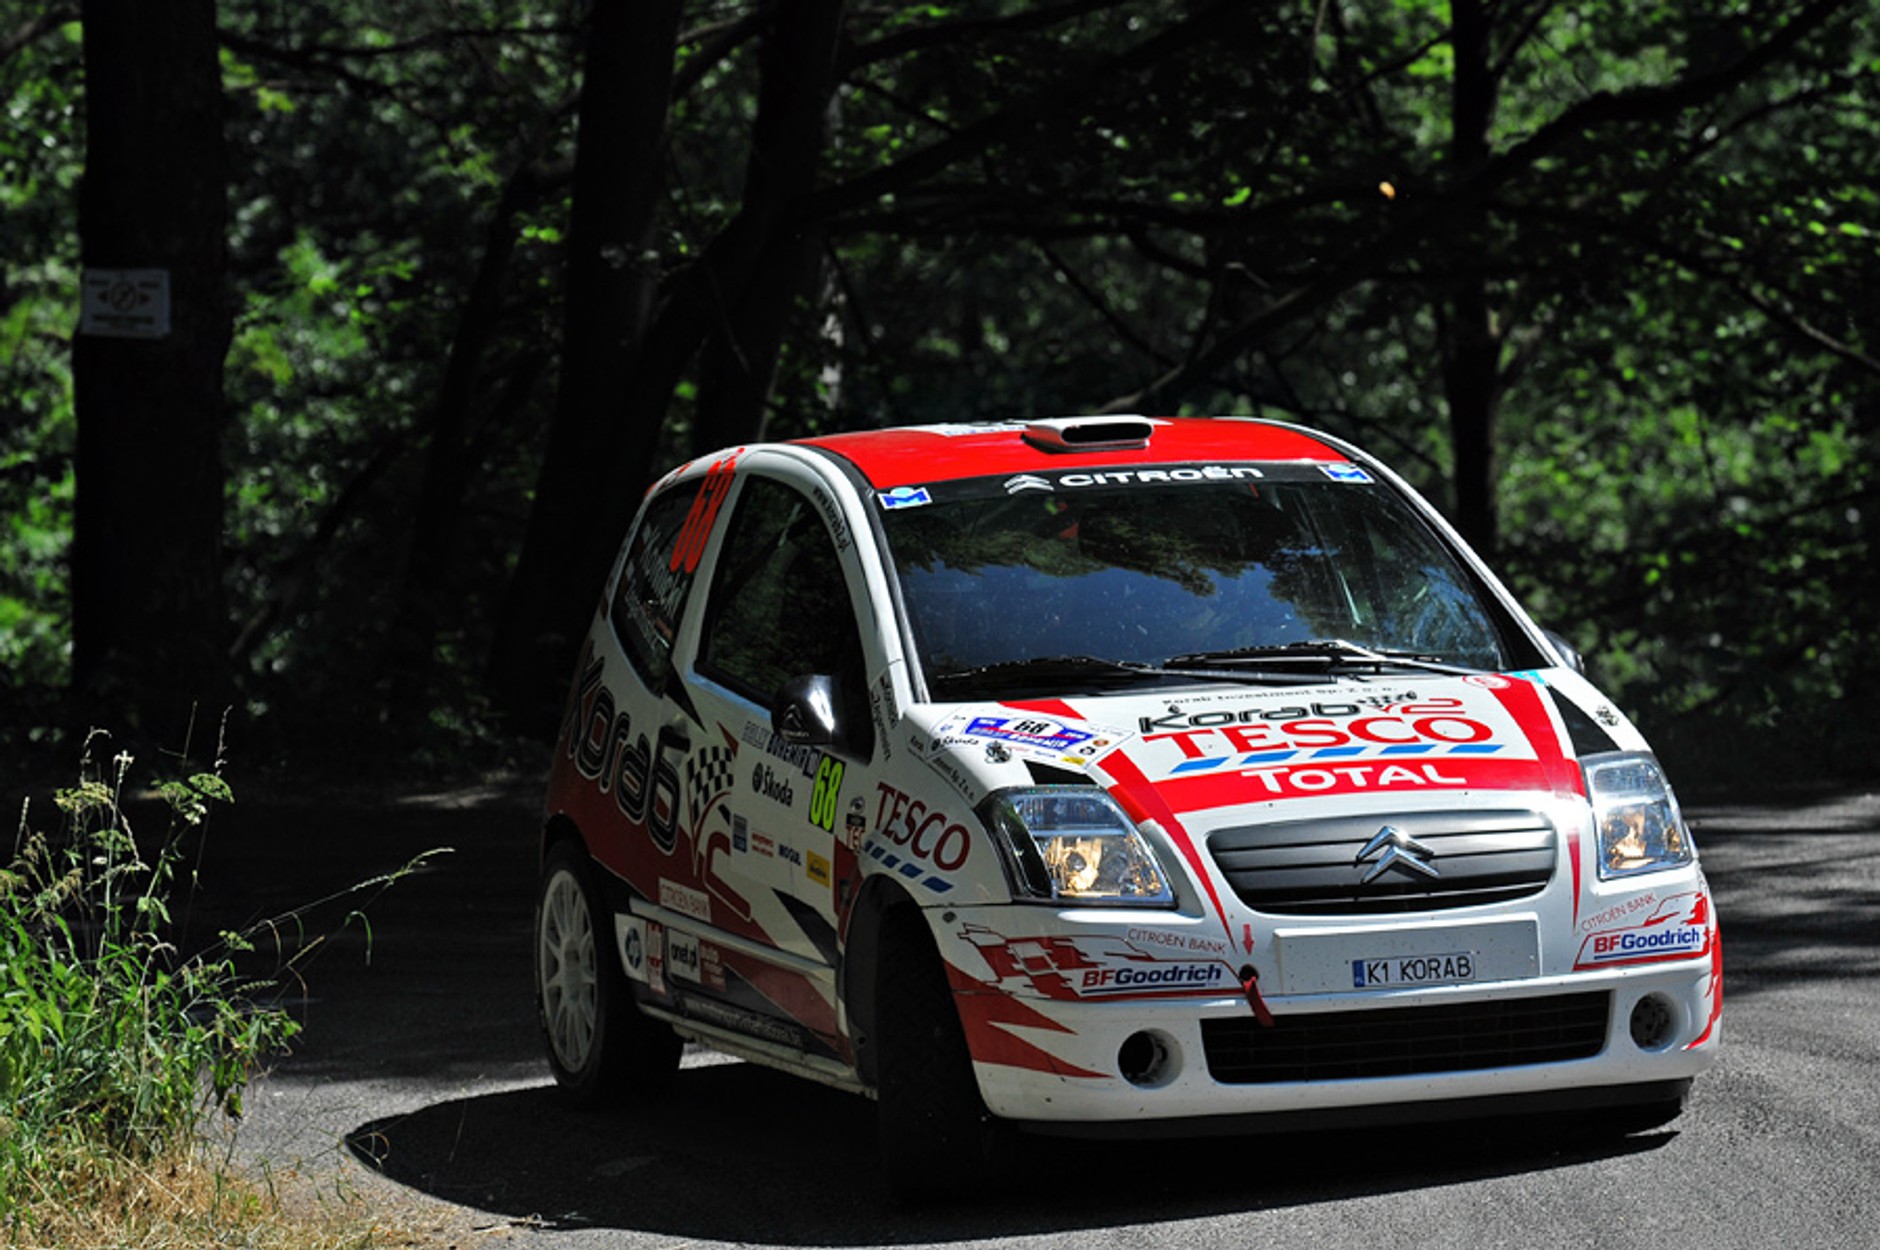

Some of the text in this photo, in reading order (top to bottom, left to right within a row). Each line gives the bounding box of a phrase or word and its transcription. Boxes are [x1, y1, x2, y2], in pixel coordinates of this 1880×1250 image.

[668, 461, 736, 574] 68
[1012, 719, 1052, 735] 68
[1142, 715, 1494, 763] TESCO
[811, 754, 845, 832] 68
[1241, 764, 1467, 793] TOTAL
[875, 781, 971, 871] TESCO
[1627, 892, 1657, 913] BANK
[1188, 938, 1227, 954] BANK
[1593, 926, 1700, 953] BFGoodrich
[1082, 964, 1222, 987] BFGoodrich
[1367, 955, 1472, 984] K1 KORAB
